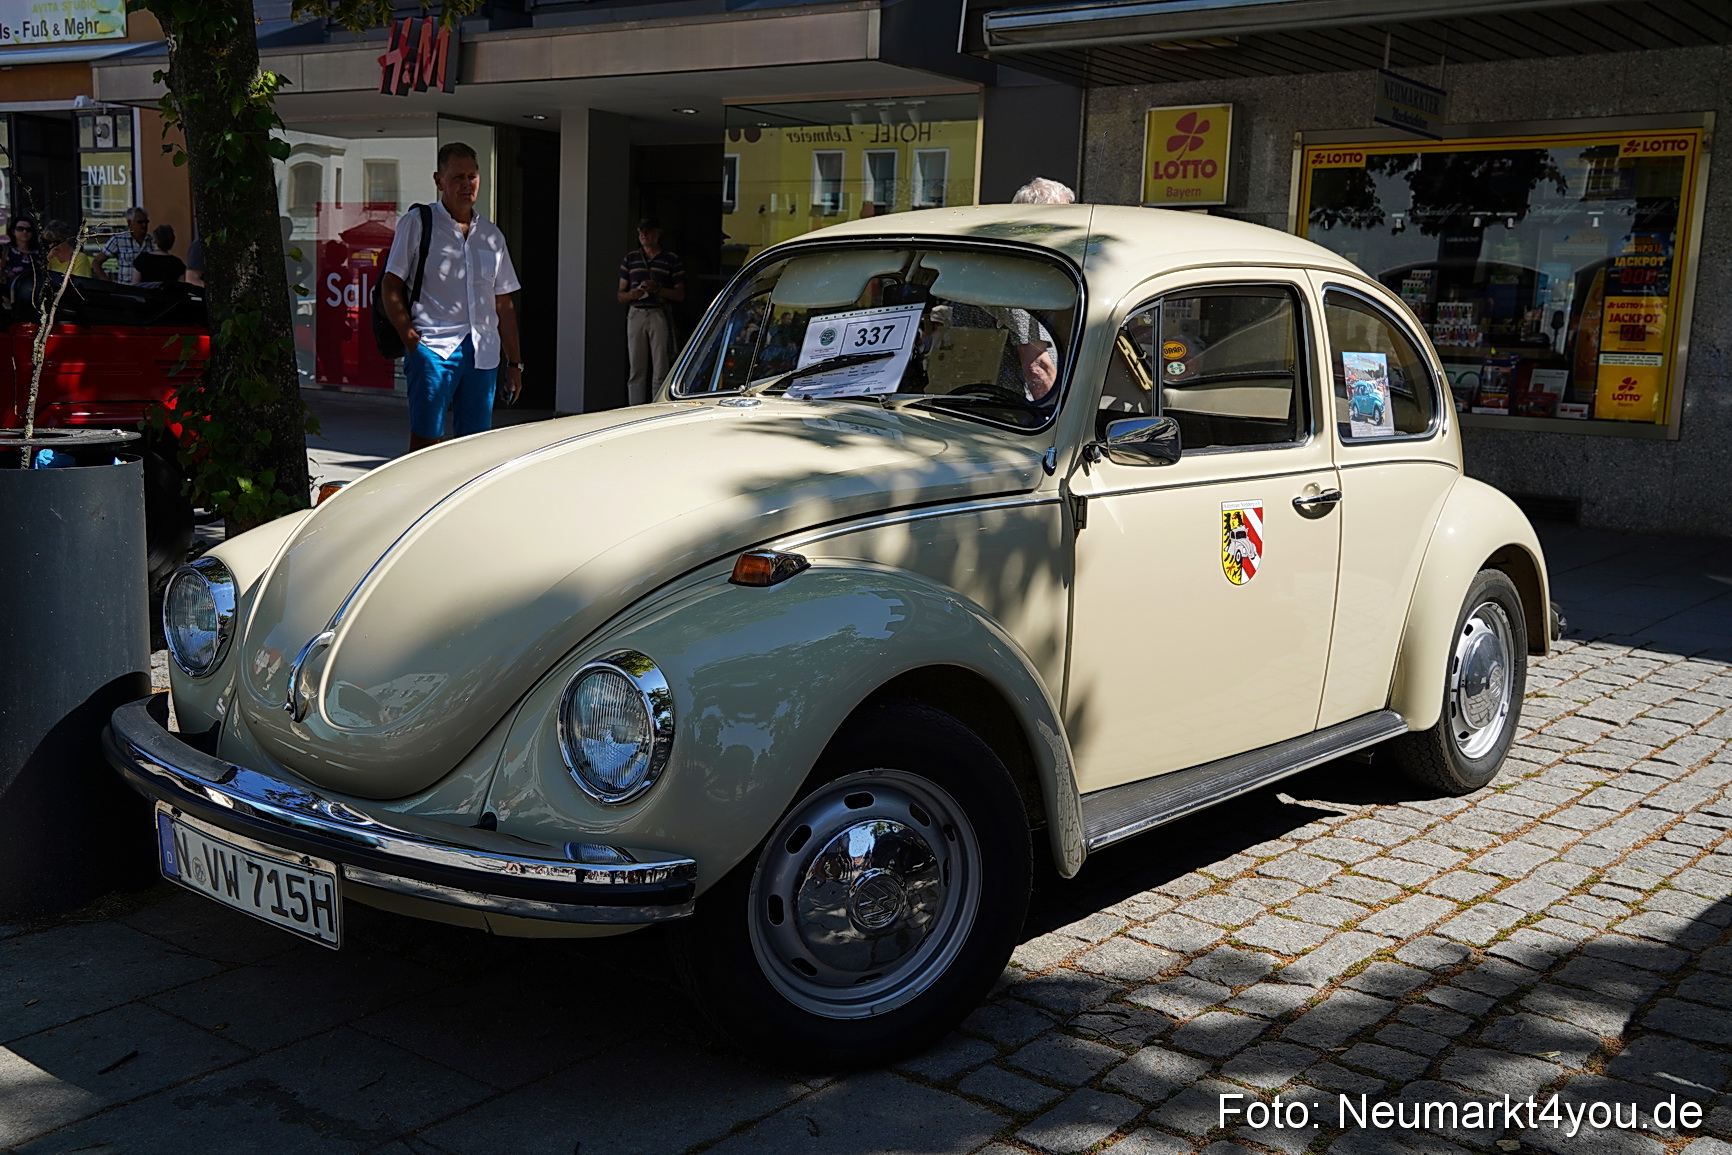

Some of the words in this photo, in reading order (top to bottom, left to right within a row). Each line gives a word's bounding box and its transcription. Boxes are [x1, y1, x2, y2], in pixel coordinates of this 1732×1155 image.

[23, 20, 49, 38] Fuß
[53, 23, 60, 36] &
[64, 17, 99, 36] Mehr
[377, 16, 456, 95] H&M
[1642, 138, 1689, 153] LOTTO
[1326, 152, 1363, 164] LOTTO
[87, 165, 126, 185] NAILS
[1153, 159, 1218, 179] LOTTO
[1166, 186, 1201, 199] Bayern
[1613, 256, 1667, 267] JACKPOT
[326, 272, 375, 309] Sal
[1609, 313, 1660, 323] JACKPOT
[854, 325, 896, 347] 337
[1612, 393, 1640, 401] LOTTO
[167, 850, 173, 864] D
[172, 828, 192, 879] N
[202, 843, 240, 900] VW
[246, 860, 335, 933] 715H
